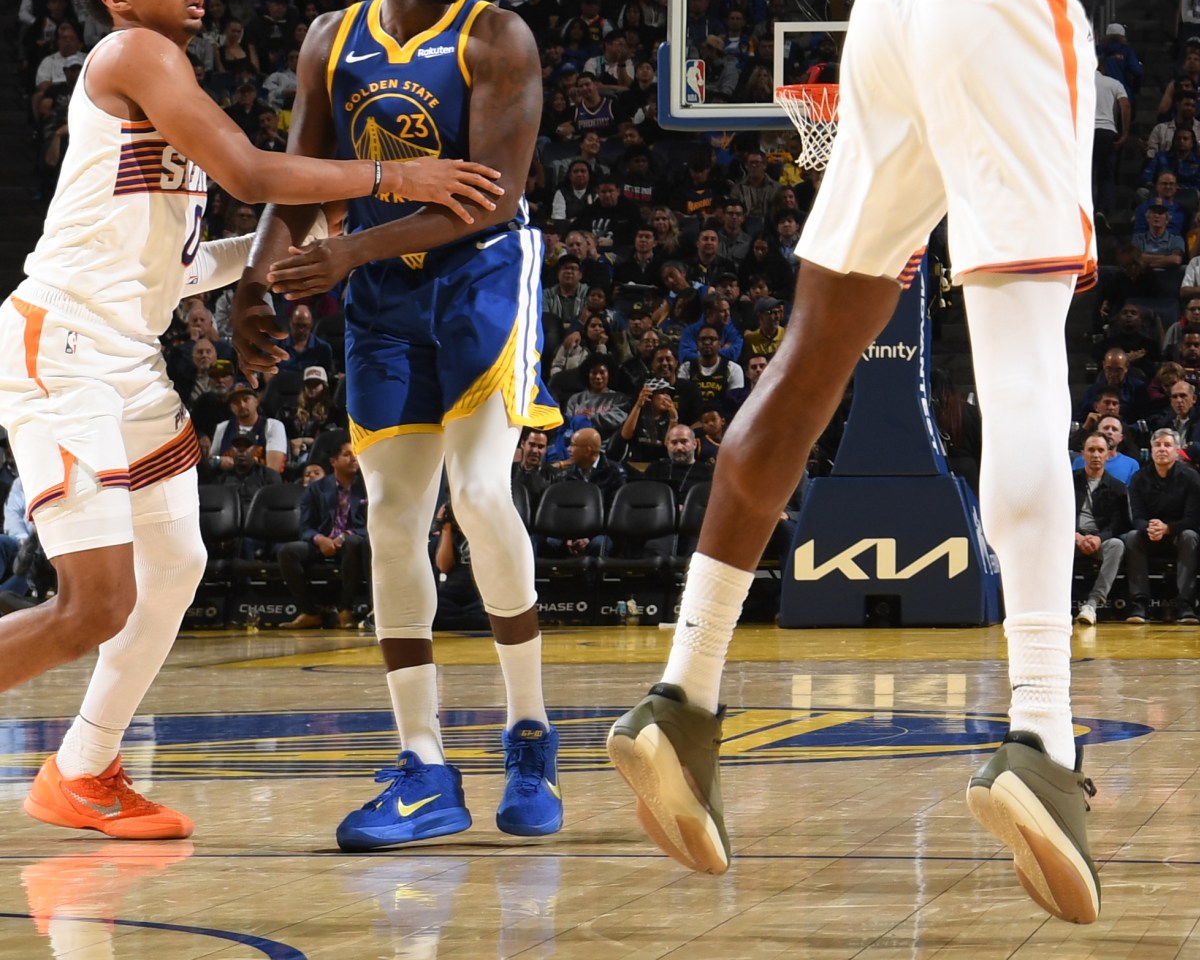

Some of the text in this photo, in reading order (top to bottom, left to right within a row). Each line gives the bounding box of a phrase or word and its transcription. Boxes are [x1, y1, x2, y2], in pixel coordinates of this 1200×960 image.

[418, 44, 456, 58] Rakuten
[345, 78, 441, 112] GOLDEN STATE
[396, 113, 430, 139] 23
[794, 537, 969, 581] KIA
[239, 603, 283, 614] CHASE
[601, 606, 645, 615] CHE
